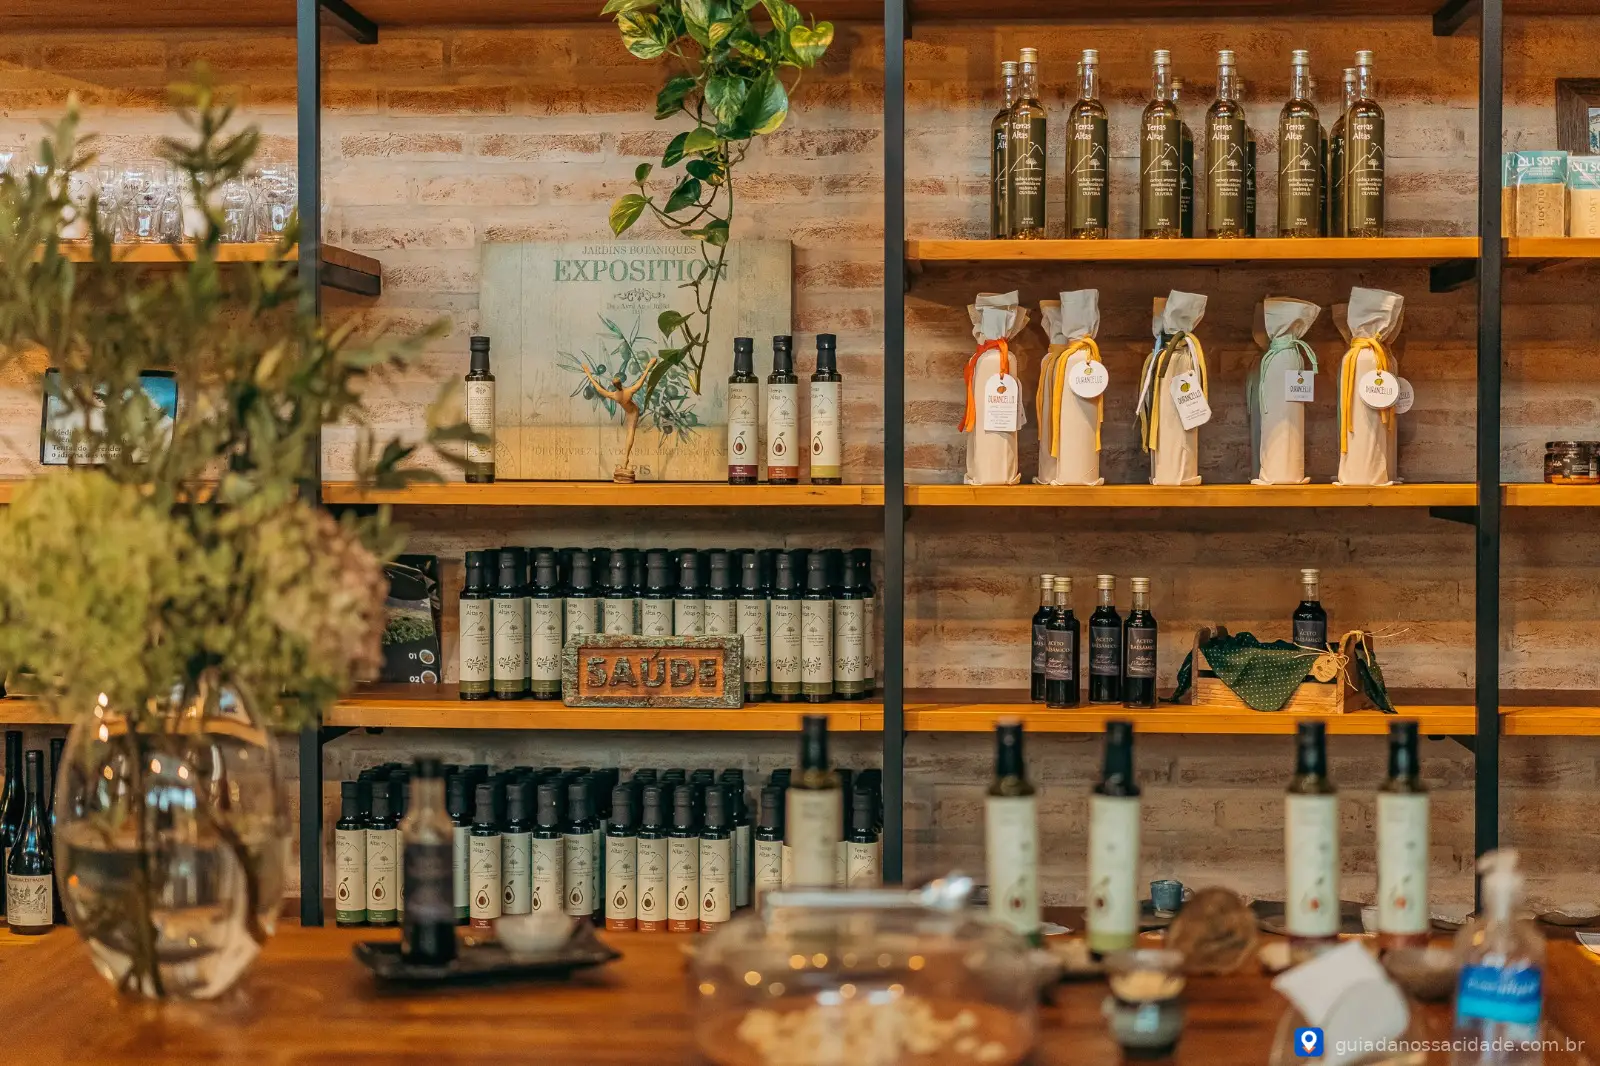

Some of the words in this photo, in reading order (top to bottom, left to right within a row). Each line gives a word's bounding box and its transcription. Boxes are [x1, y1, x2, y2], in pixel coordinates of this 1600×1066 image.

[1012, 122, 1031, 130] Terras
[1285, 123, 1306, 131] Terras
[1353, 123, 1373, 131] Terras
[1012, 131, 1029, 140] Altas
[1074, 132, 1092, 140] Altas
[1147, 132, 1164, 140] Altas
[1212, 132, 1230, 140] Altas
[1285, 132, 1302, 140] Altas
[1352, 132, 1370, 140] Altas
[1537, 157, 1562, 166] SOFT
[582, 246, 628, 256] JARDINS
[630, 246, 696, 256] BOTANIQUES
[552, 260, 730, 282] EXPOSITION
[587, 648, 718, 688] SAÚDE
